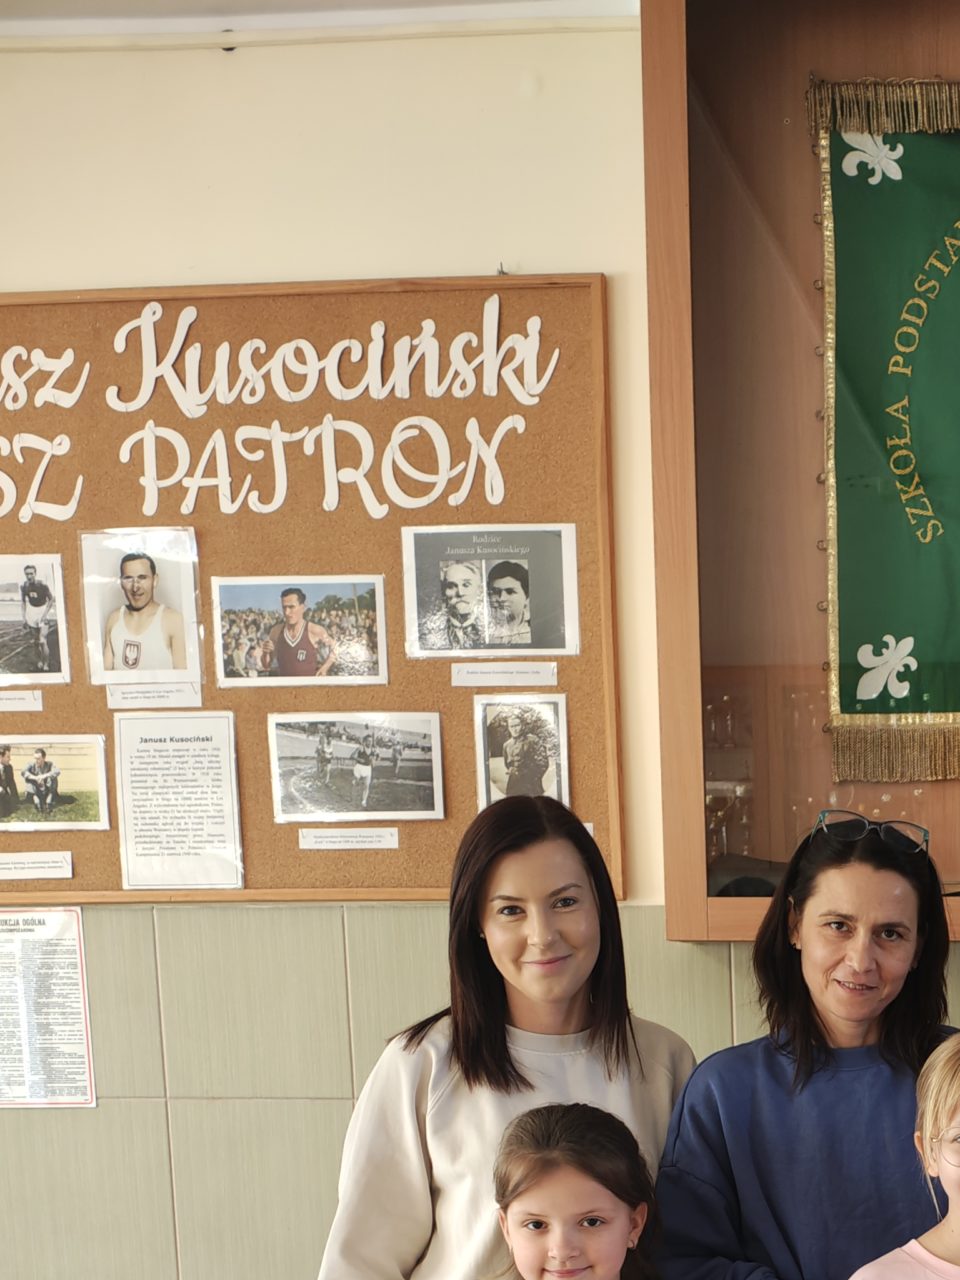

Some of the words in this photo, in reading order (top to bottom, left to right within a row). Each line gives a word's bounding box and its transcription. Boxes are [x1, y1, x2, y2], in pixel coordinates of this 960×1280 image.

[105, 293, 560, 419] Kusociński
[119, 413, 526, 519] PATRON
[885, 395, 944, 544] SZKOŁA
[139, 736, 167, 744] Janusz
[169, 735, 213, 743] Kusociński
